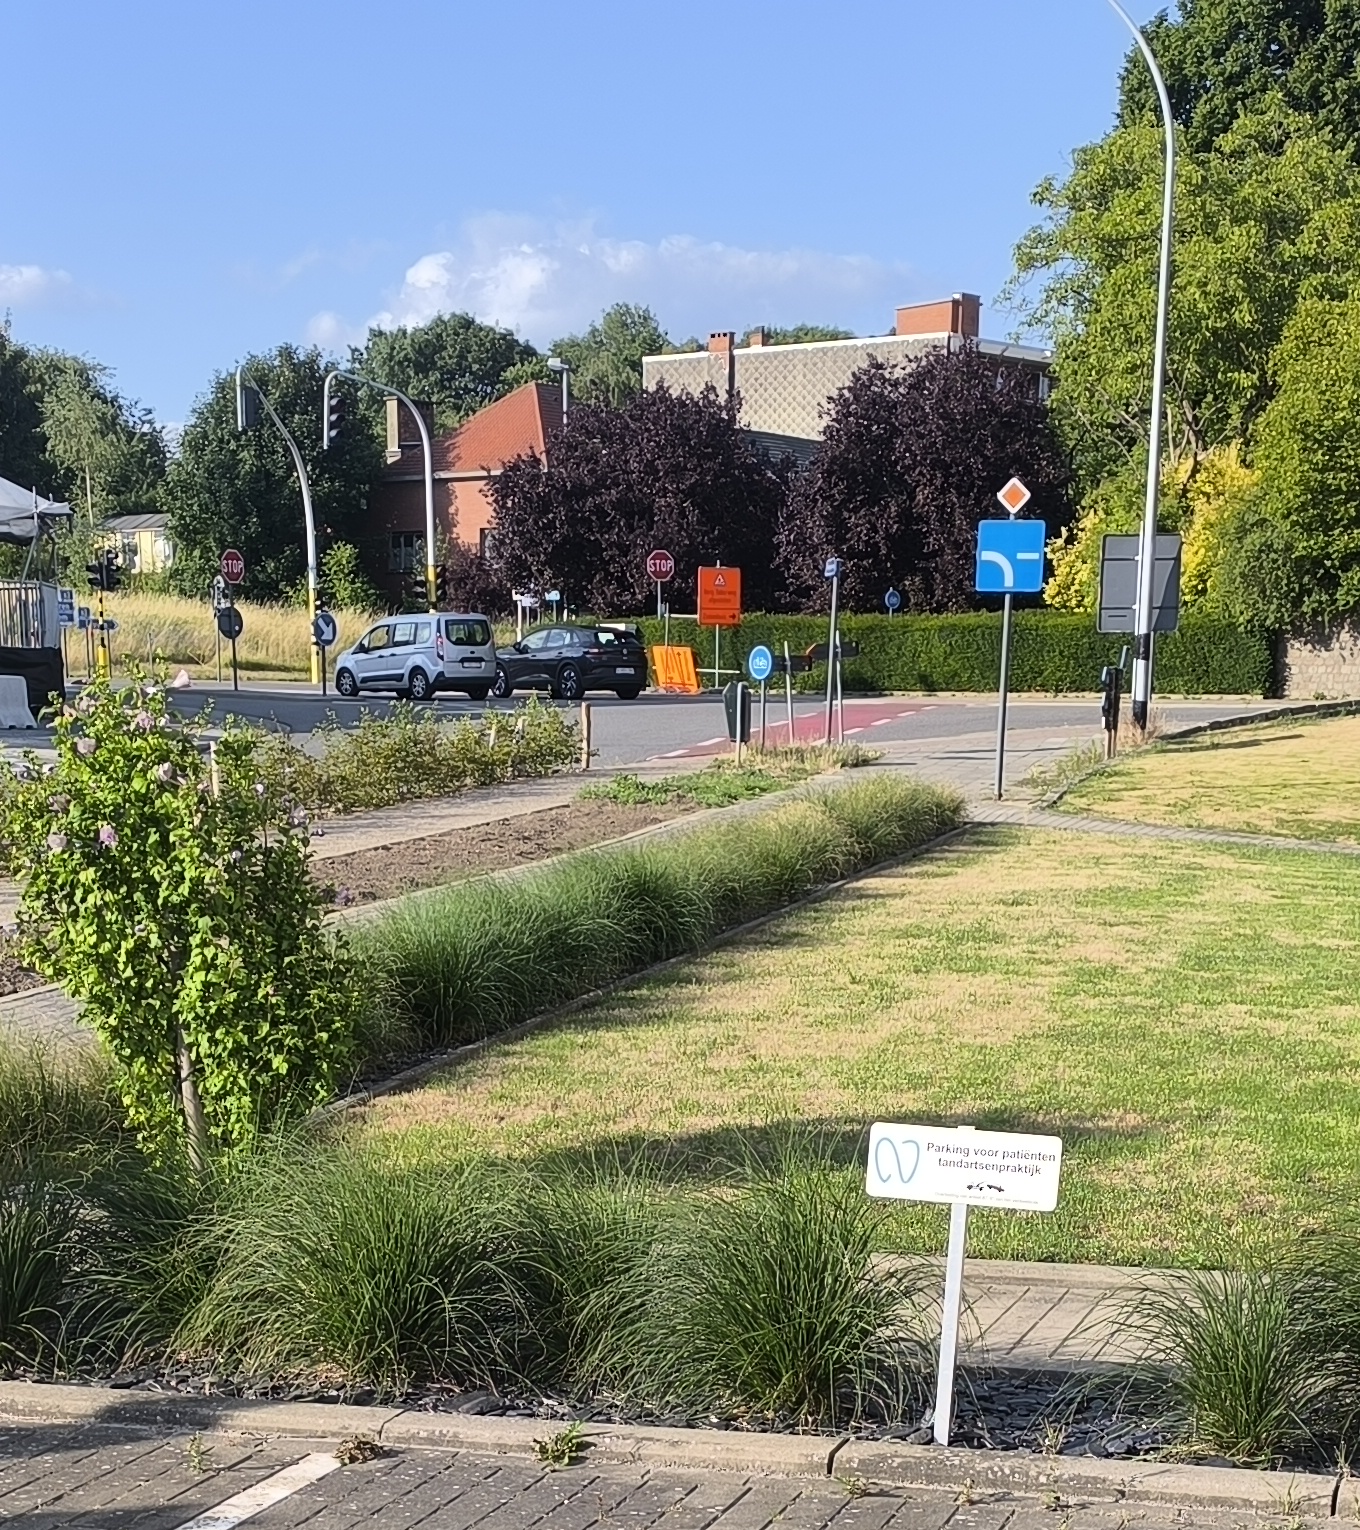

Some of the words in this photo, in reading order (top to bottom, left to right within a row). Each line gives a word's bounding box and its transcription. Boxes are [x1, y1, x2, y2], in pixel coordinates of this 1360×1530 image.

[222, 560, 244, 573] STOP
[649, 559, 673, 572] STOP
[927, 1142, 970, 1157] Parking
[974, 1148, 999, 1158] voor
[1002, 1149, 1056, 1162] patiënten
[938, 1157, 1042, 1176] tandartsenpraktijk
